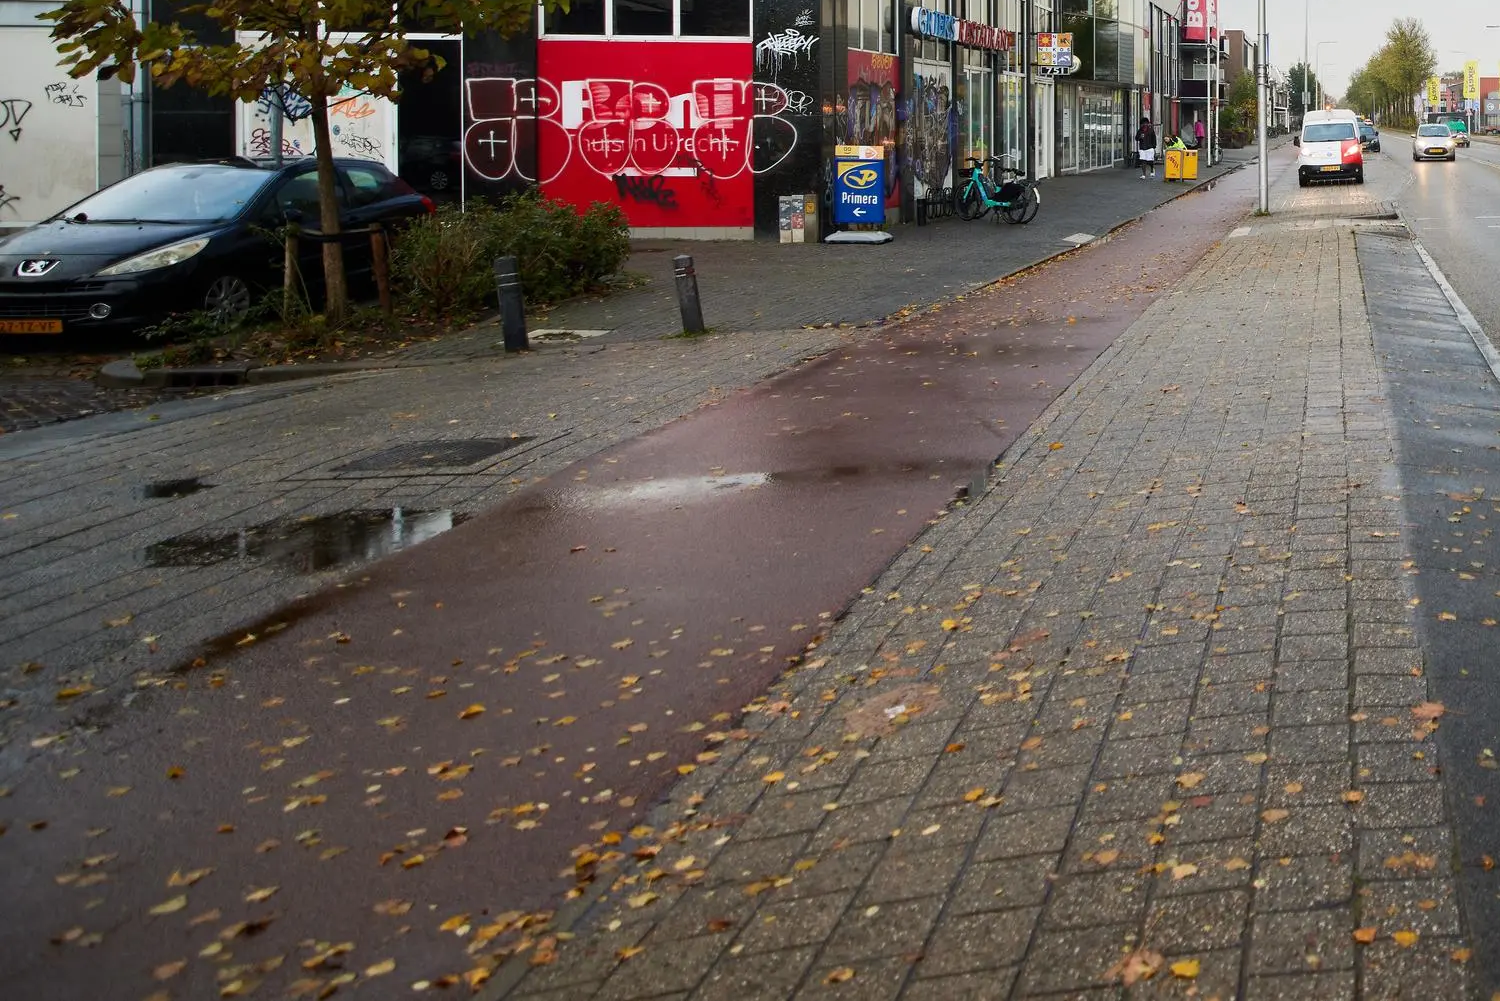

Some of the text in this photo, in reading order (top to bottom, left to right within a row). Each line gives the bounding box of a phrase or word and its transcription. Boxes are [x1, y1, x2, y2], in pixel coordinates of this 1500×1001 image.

[1046, 66, 1064, 75] 751
[562, 78, 734, 130] Boni
[842, 192, 878, 205] Primera
